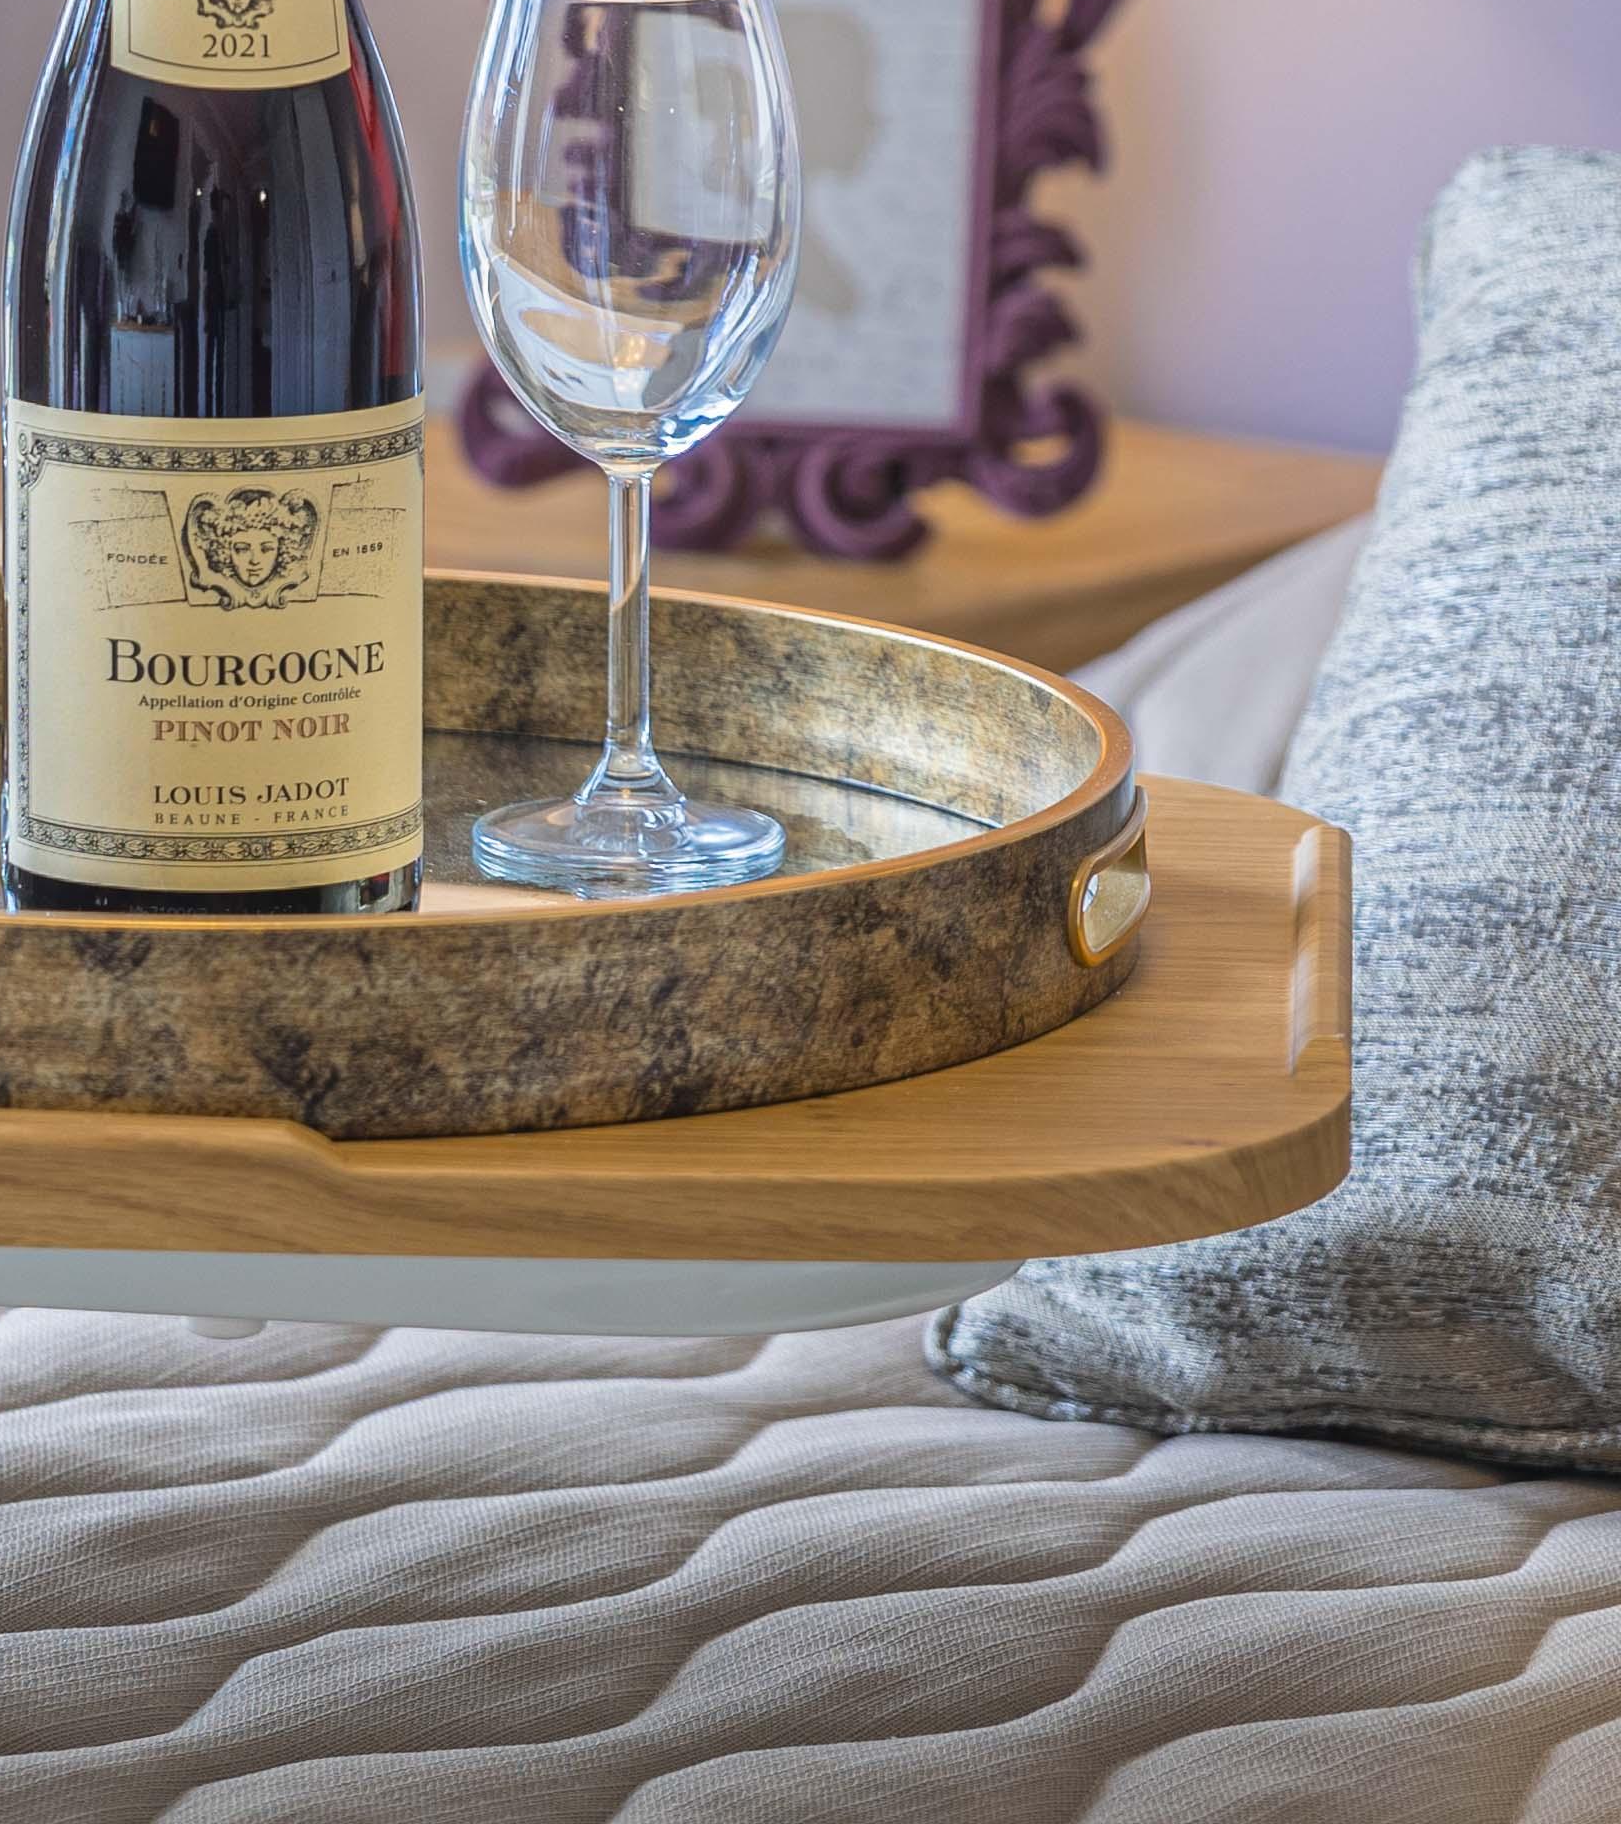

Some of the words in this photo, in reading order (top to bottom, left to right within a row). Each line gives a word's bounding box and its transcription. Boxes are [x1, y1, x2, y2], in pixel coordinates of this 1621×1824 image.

[202, 33, 271, 58] 2021
[107, 552, 169, 565] FONDÉE
[332, 547, 350, 558] EN
[138, 695, 225, 710] Appellation
[229, 694, 298, 710] d'Origine
[302, 686, 362, 706] Contrôlée
[153, 719, 262, 743] PINOT
[272, 712, 351, 741] NOIR
[153, 784, 247, 806] LOUIS
[257, 777, 350, 805] JADOT
[154, 813, 242, 825] BEAUNE
[273, 805, 349, 824] FRANCE
